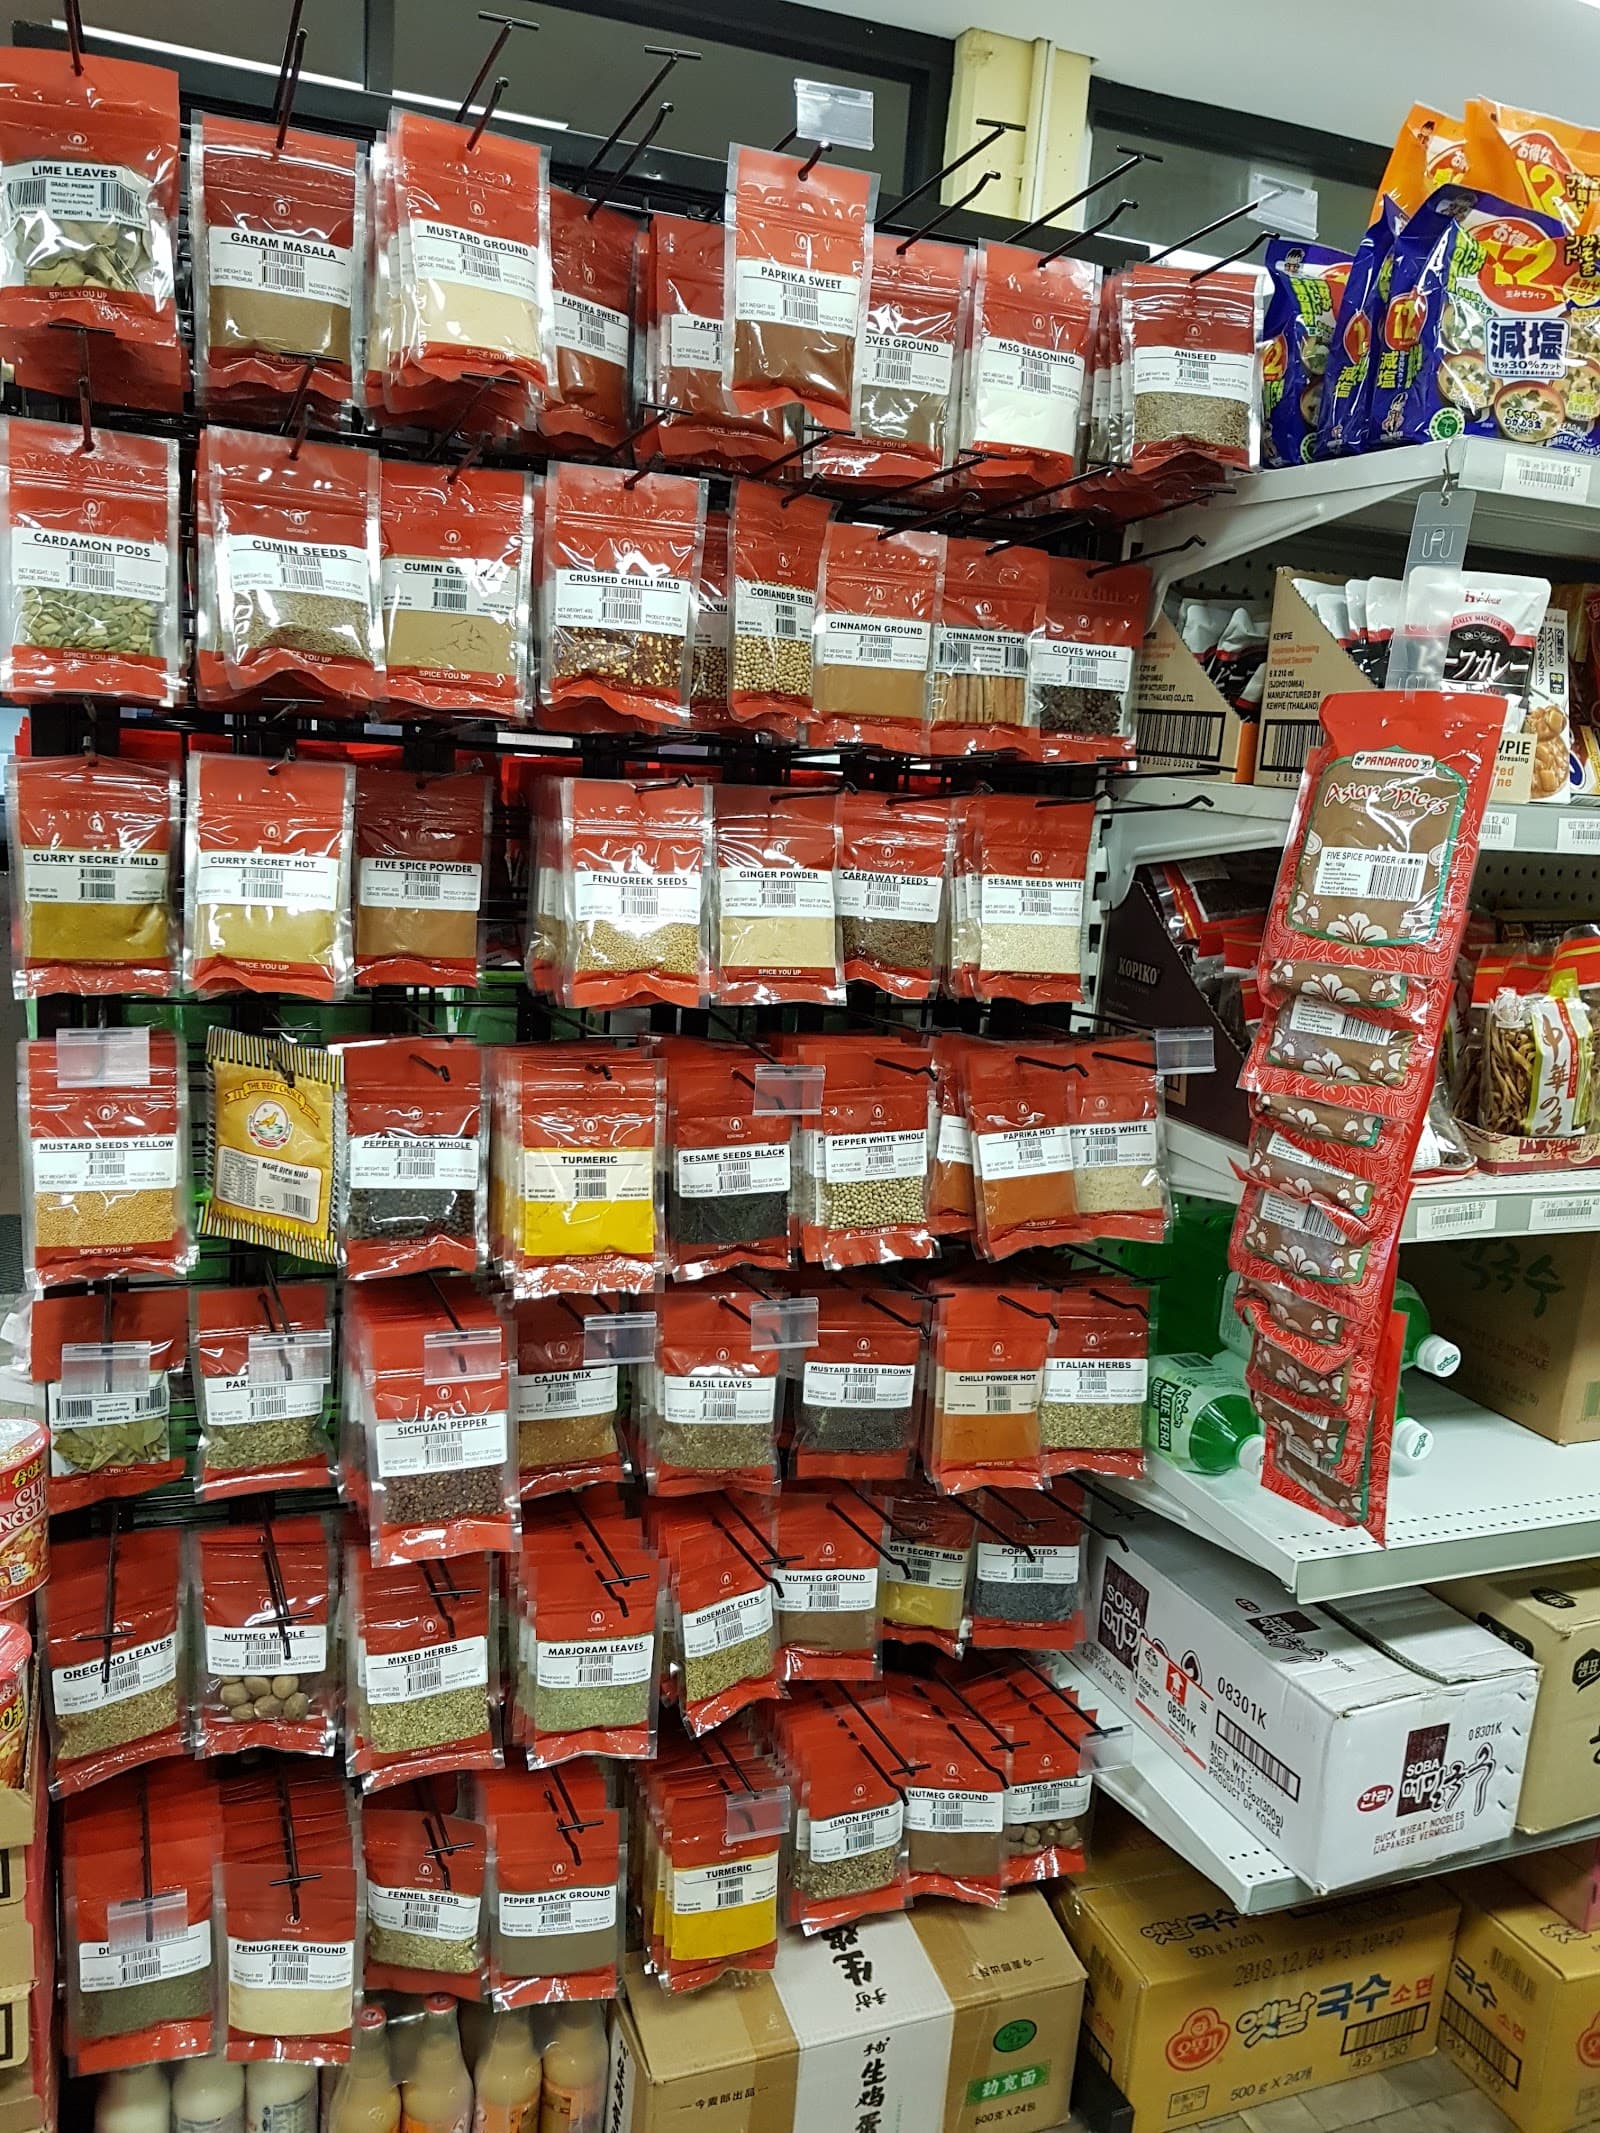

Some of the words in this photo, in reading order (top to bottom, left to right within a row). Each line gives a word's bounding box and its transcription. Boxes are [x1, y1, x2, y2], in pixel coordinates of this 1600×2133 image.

[32, 166, 61, 176] LIME
[66, 167, 118, 178] LEAVES
[231, 232, 279, 249] GARAM
[283, 241, 337, 260] MASALA
[426, 225, 480, 245] MUSTARD
[484, 239, 529, 257] GROUND
[761, 266, 805, 285] PAPRIKA
[809, 276, 842, 290] SWEET
[562, 296, 595, 315] PAPRIKA
[596, 308, 620, 324] SWEET
[893, 339, 939, 354] GROUND
[1490, 321, 1564, 360] 減塩
[999, 341, 1020, 355] MSG
[1022, 346, 1076, 365] SEASONING
[1174, 350, 1217, 361] ANISEED
[34, 533, 112, 553] CARDAMON
[117, 544, 151, 558] PODS
[252, 539, 299, 555] CUMIN
[303, 546, 348, 559] SEEDS
[404, 562, 442, 574] CUMIN
[569, 574, 618, 586] CRUSHED
[621, 576, 655, 588] CHILLI
[656, 579, 680, 590] MILD
[751, 587, 796, 602] CORIANDER
[830, 621, 882, 634] CINNAMON
[884, 624, 923, 636] GROUND
[946, 632, 996, 644] CINNAMON
[1272, 631, 1293, 641] KEWPIE
[1052, 645, 1084, 656] CLOVES
[1085, 648, 1118, 658] WHOLE
[443, 672, 459, 680] YOU
[1267, 690, 1310, 700] MANUFACTURED
[1311, 690, 1321, 699] BY
[1266, 701, 1287, 710] KEWPIE
[1364, 756, 1419, 769] PANDAROO
[1499, 755, 1529, 764] Dressing
[1323, 783, 1380, 808] Asian
[1491, 815, 1510, 825] $2.40
[33, 853, 75, 864] CURRY
[130, 856, 159, 867] MILD
[210, 856, 246, 866] CURRY
[250, 857, 291, 868] SECRET
[295, 860, 317, 869] HOT
[1326, 851, 1340, 860] FIVE
[1342, 852, 1363, 862] SPICE
[1364, 853, 1396, 864] POWDER
[375, 860, 398, 870] FIVE
[399, 860, 428, 872] SPICE
[429, 862, 473, 874] POWDER
[592, 874, 654, 886] FENUGREEK
[656, 877, 689, 886] SEEDS
[739, 870, 777, 879] GINGER
[780, 870, 819, 880] POWDER
[842, 871, 899, 885] CARRAWAY
[900, 875, 929, 886] SEEDS
[987, 878, 1024, 888] SESAME
[1025, 879, 1054, 889] SEEDS
[1003, 1130, 1037, 1140] PAPRIKA
[1039, 1127, 1056, 1137] HOT
[1089, 1125, 1116, 1136] SEEDS
[1118, 1123, 1148, 1135] WHITE
[40, 1142, 92, 1150] MUSTARD
[95, 1141, 129, 1149] SEEDS
[132, 1139, 173, 1149] YELLOW
[364, 1140, 401, 1148] PEPPER
[403, 1140, 436, 1148] BLACK
[439, 1140, 472, 1149] WHOLE
[832, 1137, 867, 1147] PEPPER
[869, 1134, 896, 1144] WHITE
[898, 1131, 925, 1142] WHOLE
[561, 1155, 618, 1164] TURMERIC
[682, 1153, 721, 1163] SESAME
[723, 1150, 752, 1160] SEEDS
[754, 1148, 785, 1158] BLACK
[104, 1247, 121, 1255] YOU
[810, 1365, 851, 1375] MUSTARD
[852, 1366, 879, 1375] SEEDS
[881, 1367, 912, 1376] BROWN
[1056, 1361, 1095, 1369] ITALIAN
[1098, 1361, 1132, 1369] HERBS
[534, 1373, 570, 1384] CAJUN
[572, 1371, 592, 1380] MIX
[689, 1379, 716, 1389] BASIL
[718, 1380, 752, 1389] LEAVES
[959, 1374, 984, 1382] CHILLI
[985, 1374, 1018, 1382] POWDER
[1020, 1373, 1037, 1382] HOT
[1152, 1379, 1163, 1408] DRINK
[1160, 1383, 1174, 1415] ALOE
[397, 1422, 447, 1436] SICHUAN
[449, 1418, 488, 1430] PEPPER
[1159, 1416, 1171, 1448] VERA
[907, 1547, 940, 1558] SECRET
[942, 1552, 963, 1561] MILD
[1033, 1547, 1058, 1555] SEEDS
[785, 1574, 823, 1582] NUTMEG
[825, 1574, 866, 1582] GROUND
[696, 1605, 736, 1625] ROSEMARY
[738, 1596, 760, 1608] CUTS
[1106, 1584, 1141, 1625] SOBA
[224, 1633, 267, 1641] NUTMEG
[128, 1638, 173, 1662] LEAVES
[388, 1652, 421, 1666] MIXED
[423, 1644, 458, 1660] HERBS
[548, 1645, 607, 1656] MARJORAM
[610, 1642, 644, 1653] LEAVES
[1217, 1676, 1268, 1730] 08301K
[1167, 1700, 1198, 1738] 08301K
[1468, 1720, 1503, 1742] 08301K
[1210, 1740, 1228, 1761] NET
[1406, 1758, 1441, 1776] SOBA
[1014, 1784, 1048, 1794] NUTMEG
[1049, 1780, 1078, 1790] WHOLE
[908, 1790, 946, 1801] NUTMEG
[948, 1791, 989, 1802] GROUND
[1208, 1766, 1241, 1799] PRODUCT
[1242, 1798, 1254, 1811] OF
[1255, 1810, 1282, 1840] KOREA
[1361, 1786, 1393, 1810] 한라
[829, 1815, 860, 1829] LEMON
[861, 1808, 890, 1822] PEPPER
[1375, 1829, 1397, 1844] BUCK
[1399, 1821, 1428, 1839] WHEAT
[1429, 1811, 1465, 1832] NOODLES
[705, 1864, 753, 1879] TURMERIC
[388, 1890, 426, 1901] FENNEL
[428, 1893, 459, 1905] SEEDS
[503, 1894, 536, 1905] PEPPER
[538, 1892, 567, 1902] BLACK
[569, 1890, 611, 1900] GROUND
[236, 1943, 299, 1954] FENUGREEK
[302, 1945, 347, 1954] GROUND
[1391, 1974, 1435, 2006] 소면
[1230, 2084, 1256, 2101] 500
[1271, 2077, 1282, 2088] X
